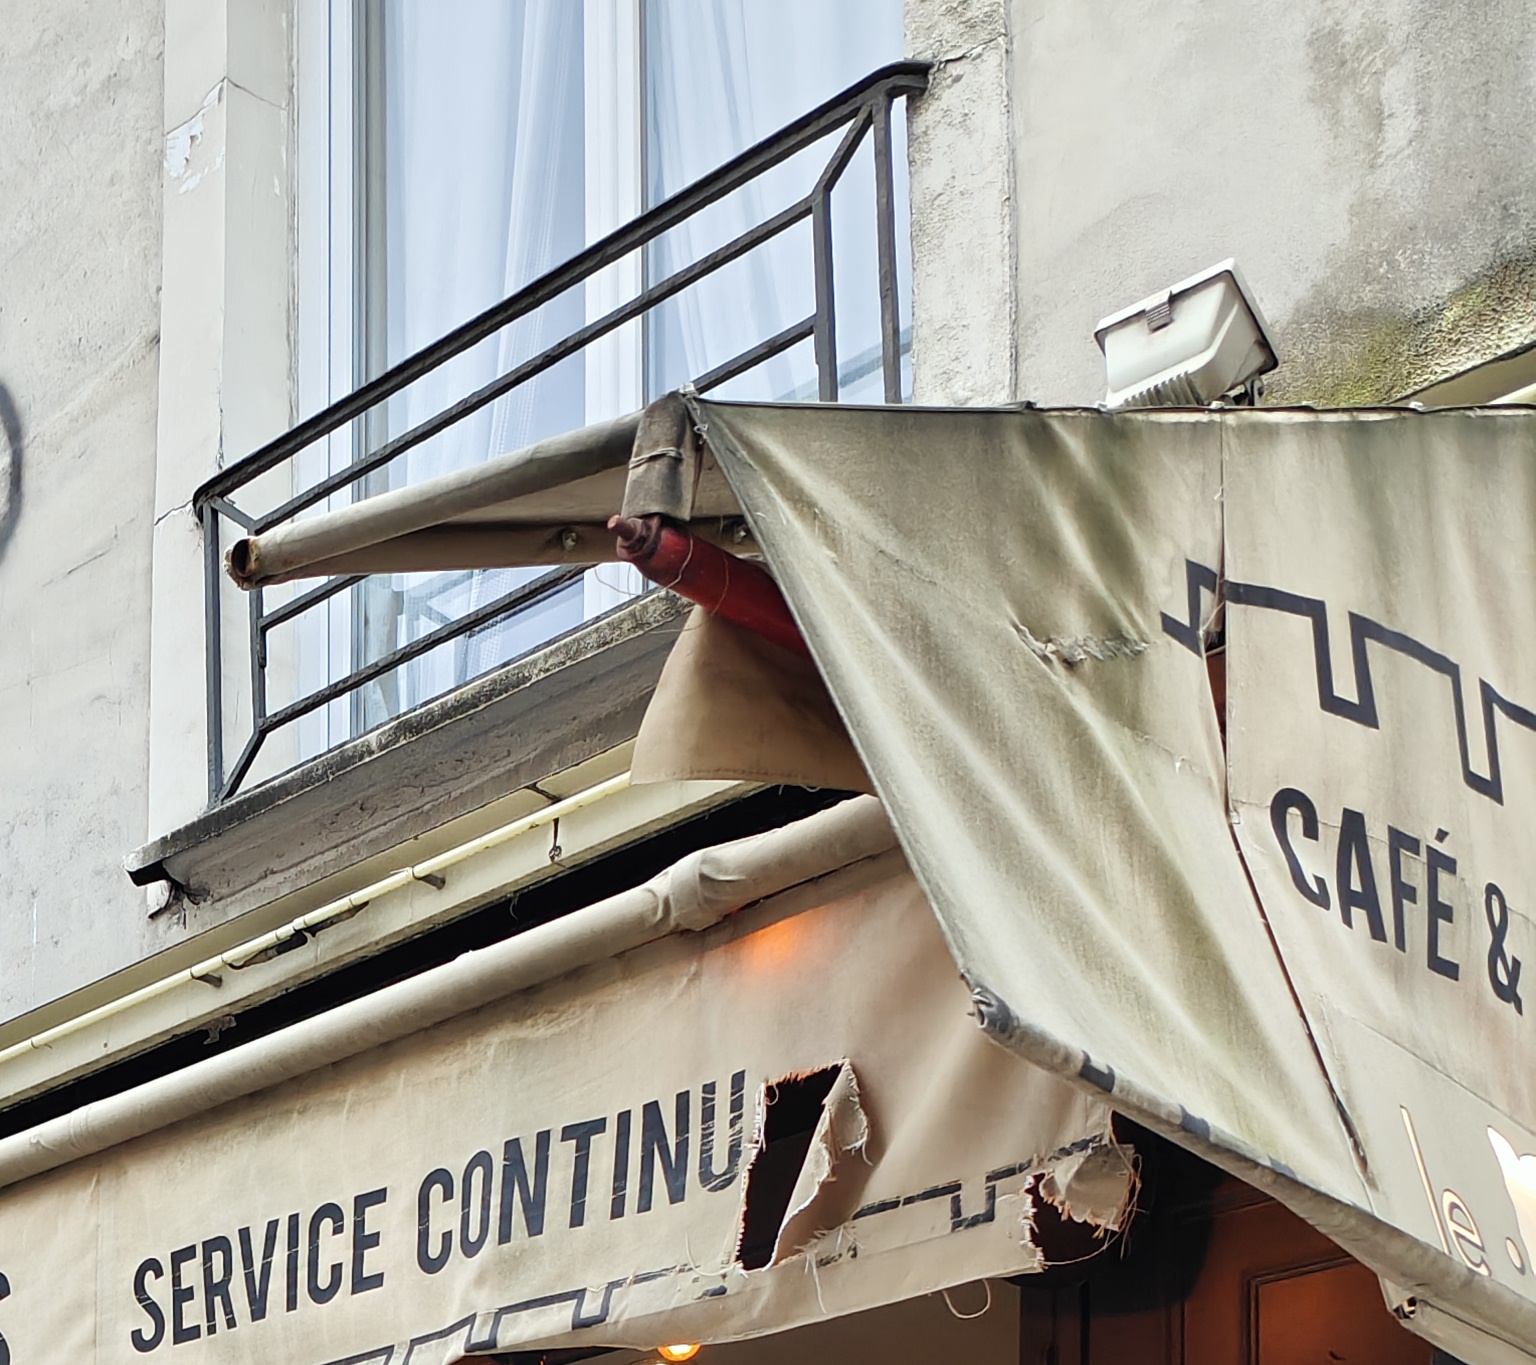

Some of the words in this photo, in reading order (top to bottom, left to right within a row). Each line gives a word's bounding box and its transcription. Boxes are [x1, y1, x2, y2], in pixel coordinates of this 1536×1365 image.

[1269, 786, 1460, 982] CAFÉ
[1484, 882, 1524, 1016] &
[131, 1187, 389, 1354] SERVICE
[416, 1069, 747, 1277] CONTINU
